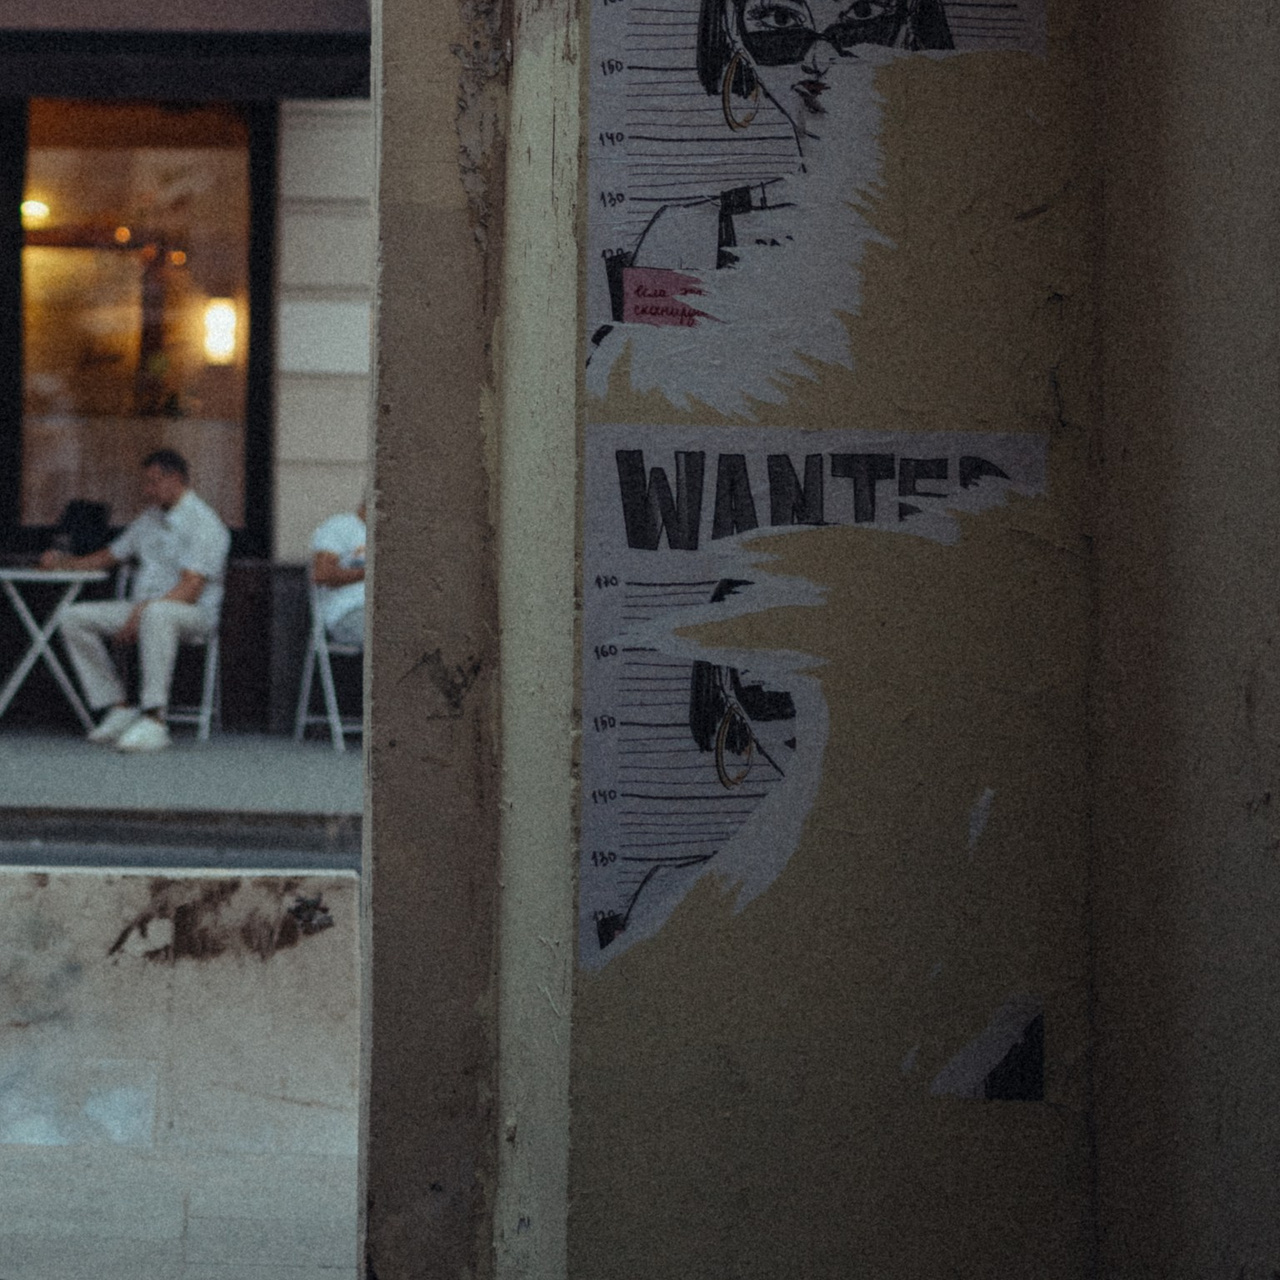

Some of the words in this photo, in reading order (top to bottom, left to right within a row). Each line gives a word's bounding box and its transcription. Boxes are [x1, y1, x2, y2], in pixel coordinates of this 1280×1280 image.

[601, 58, 624, 76] 150
[599, 132, 625, 146] 140
[600, 191, 625, 208] 130
[595, 575, 618, 589] 170
[594, 644, 618, 660] 160
[594, 714, 616, 732] 150
[592, 789, 617, 803] 140
[592, 850, 617, 867] 130
